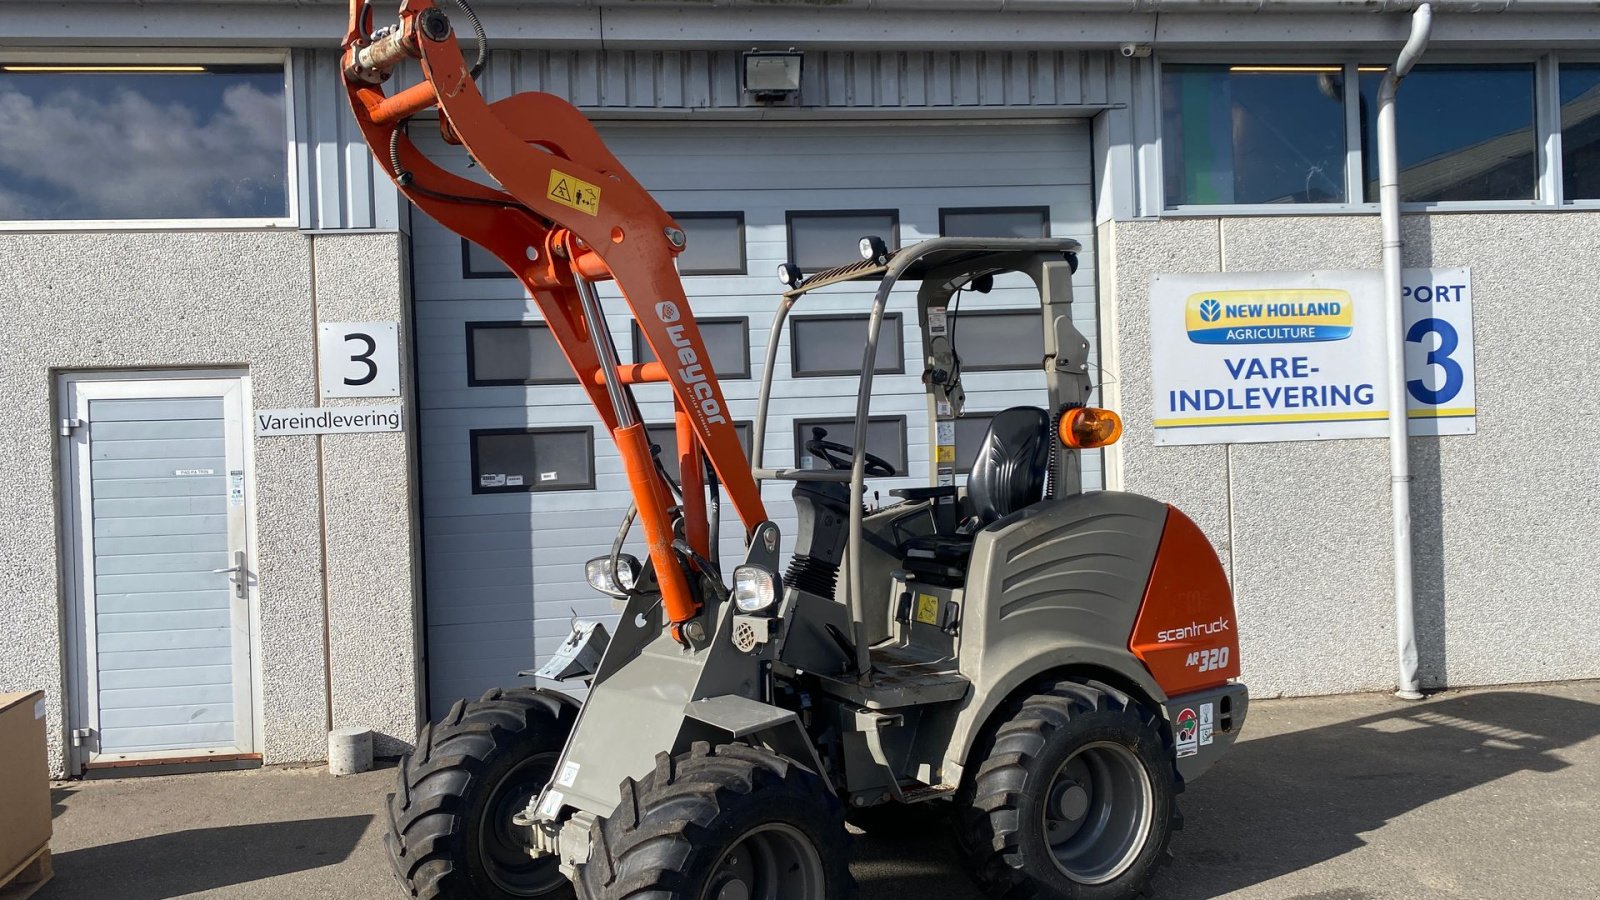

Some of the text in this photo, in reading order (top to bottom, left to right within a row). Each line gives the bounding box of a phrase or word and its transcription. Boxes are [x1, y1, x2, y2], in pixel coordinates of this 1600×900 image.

[1225, 300, 1341, 318] NEW HOLLAND
[1226, 326, 1316, 341] AGRICULTURE
[343, 333, 378, 386] 3
[1224, 356, 1319, 380] VARE-
[1405, 317, 1464, 406] 3
[665, 324, 727, 425] weycor
[1169, 383, 1375, 412] INDLEVERING
[259, 410, 400, 431] Vareindlevering
[1157, 616, 1230, 643] scantruck
